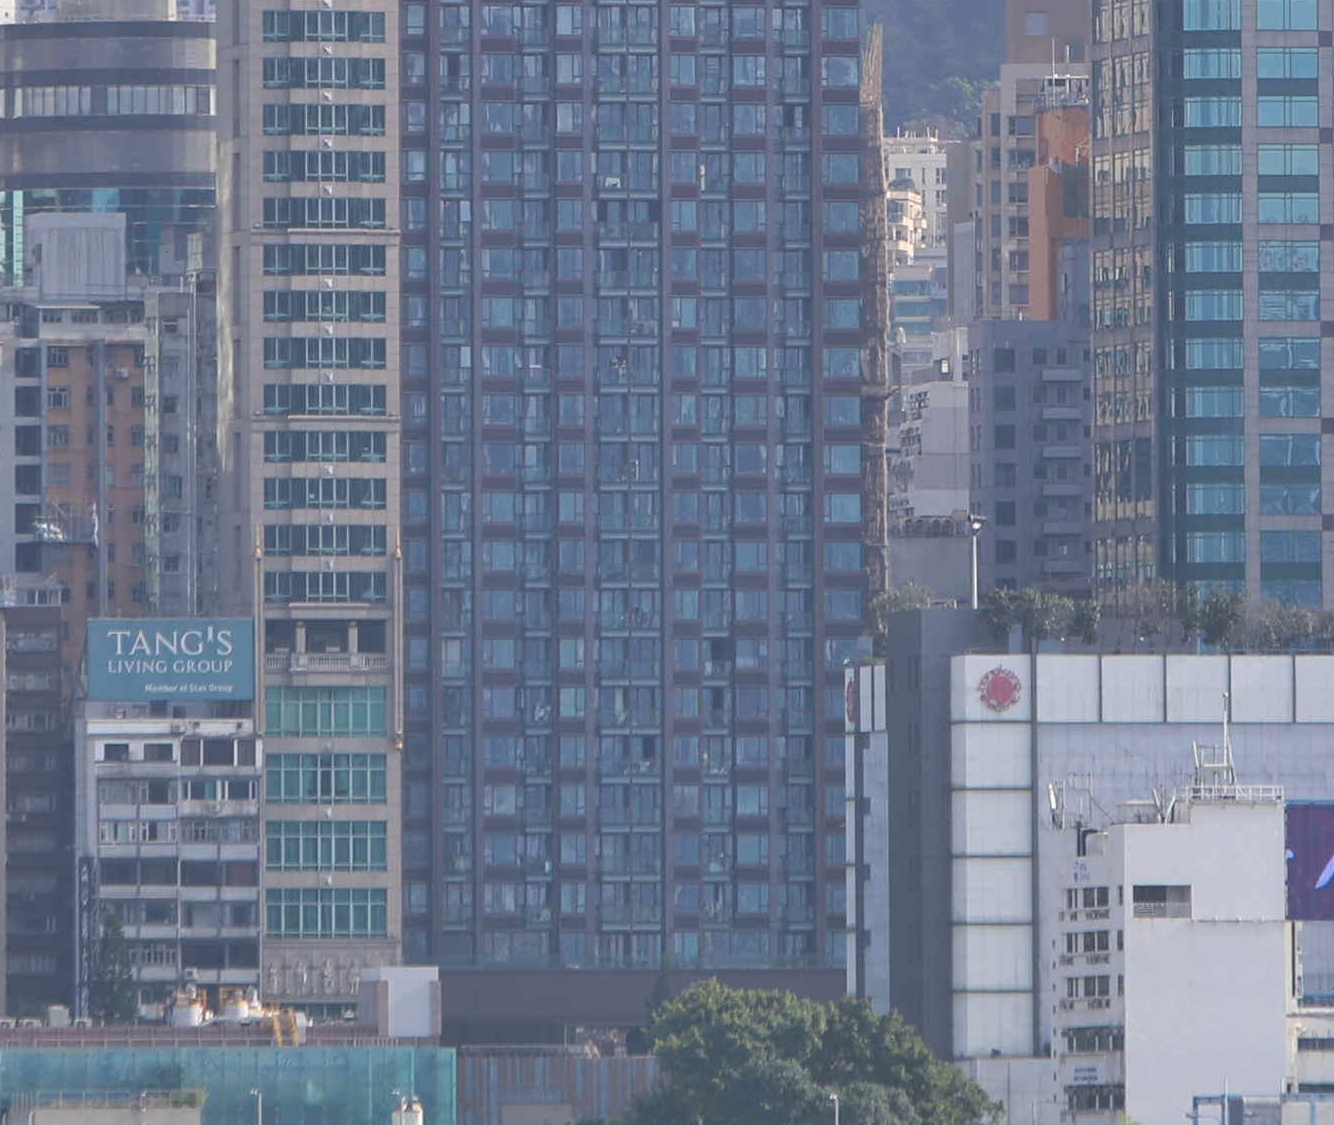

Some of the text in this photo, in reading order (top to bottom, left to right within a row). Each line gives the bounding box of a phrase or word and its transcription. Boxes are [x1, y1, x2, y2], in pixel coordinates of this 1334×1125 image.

[107, 626, 233, 656] TANG'S
[107, 659, 233, 674] LIVING GROUP
